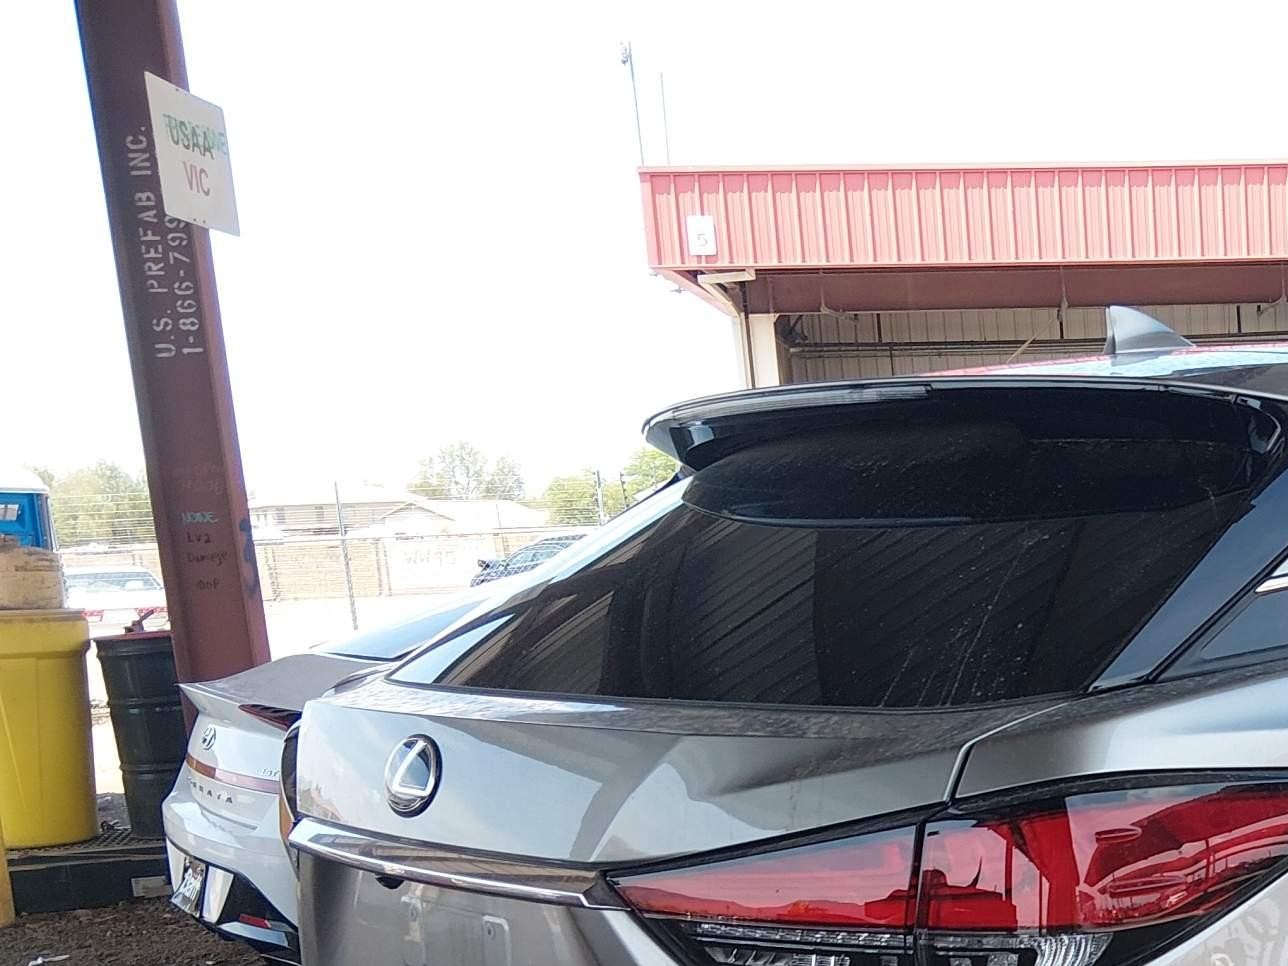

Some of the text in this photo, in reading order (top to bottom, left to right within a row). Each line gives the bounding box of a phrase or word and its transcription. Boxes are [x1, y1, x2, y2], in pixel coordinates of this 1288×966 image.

[167, 116, 215, 160] USAA
[183, 160, 211, 197] VIC
[126, 126, 176, 358] U.S. PREFAB INC.
[696, 233, 708, 247] 5
